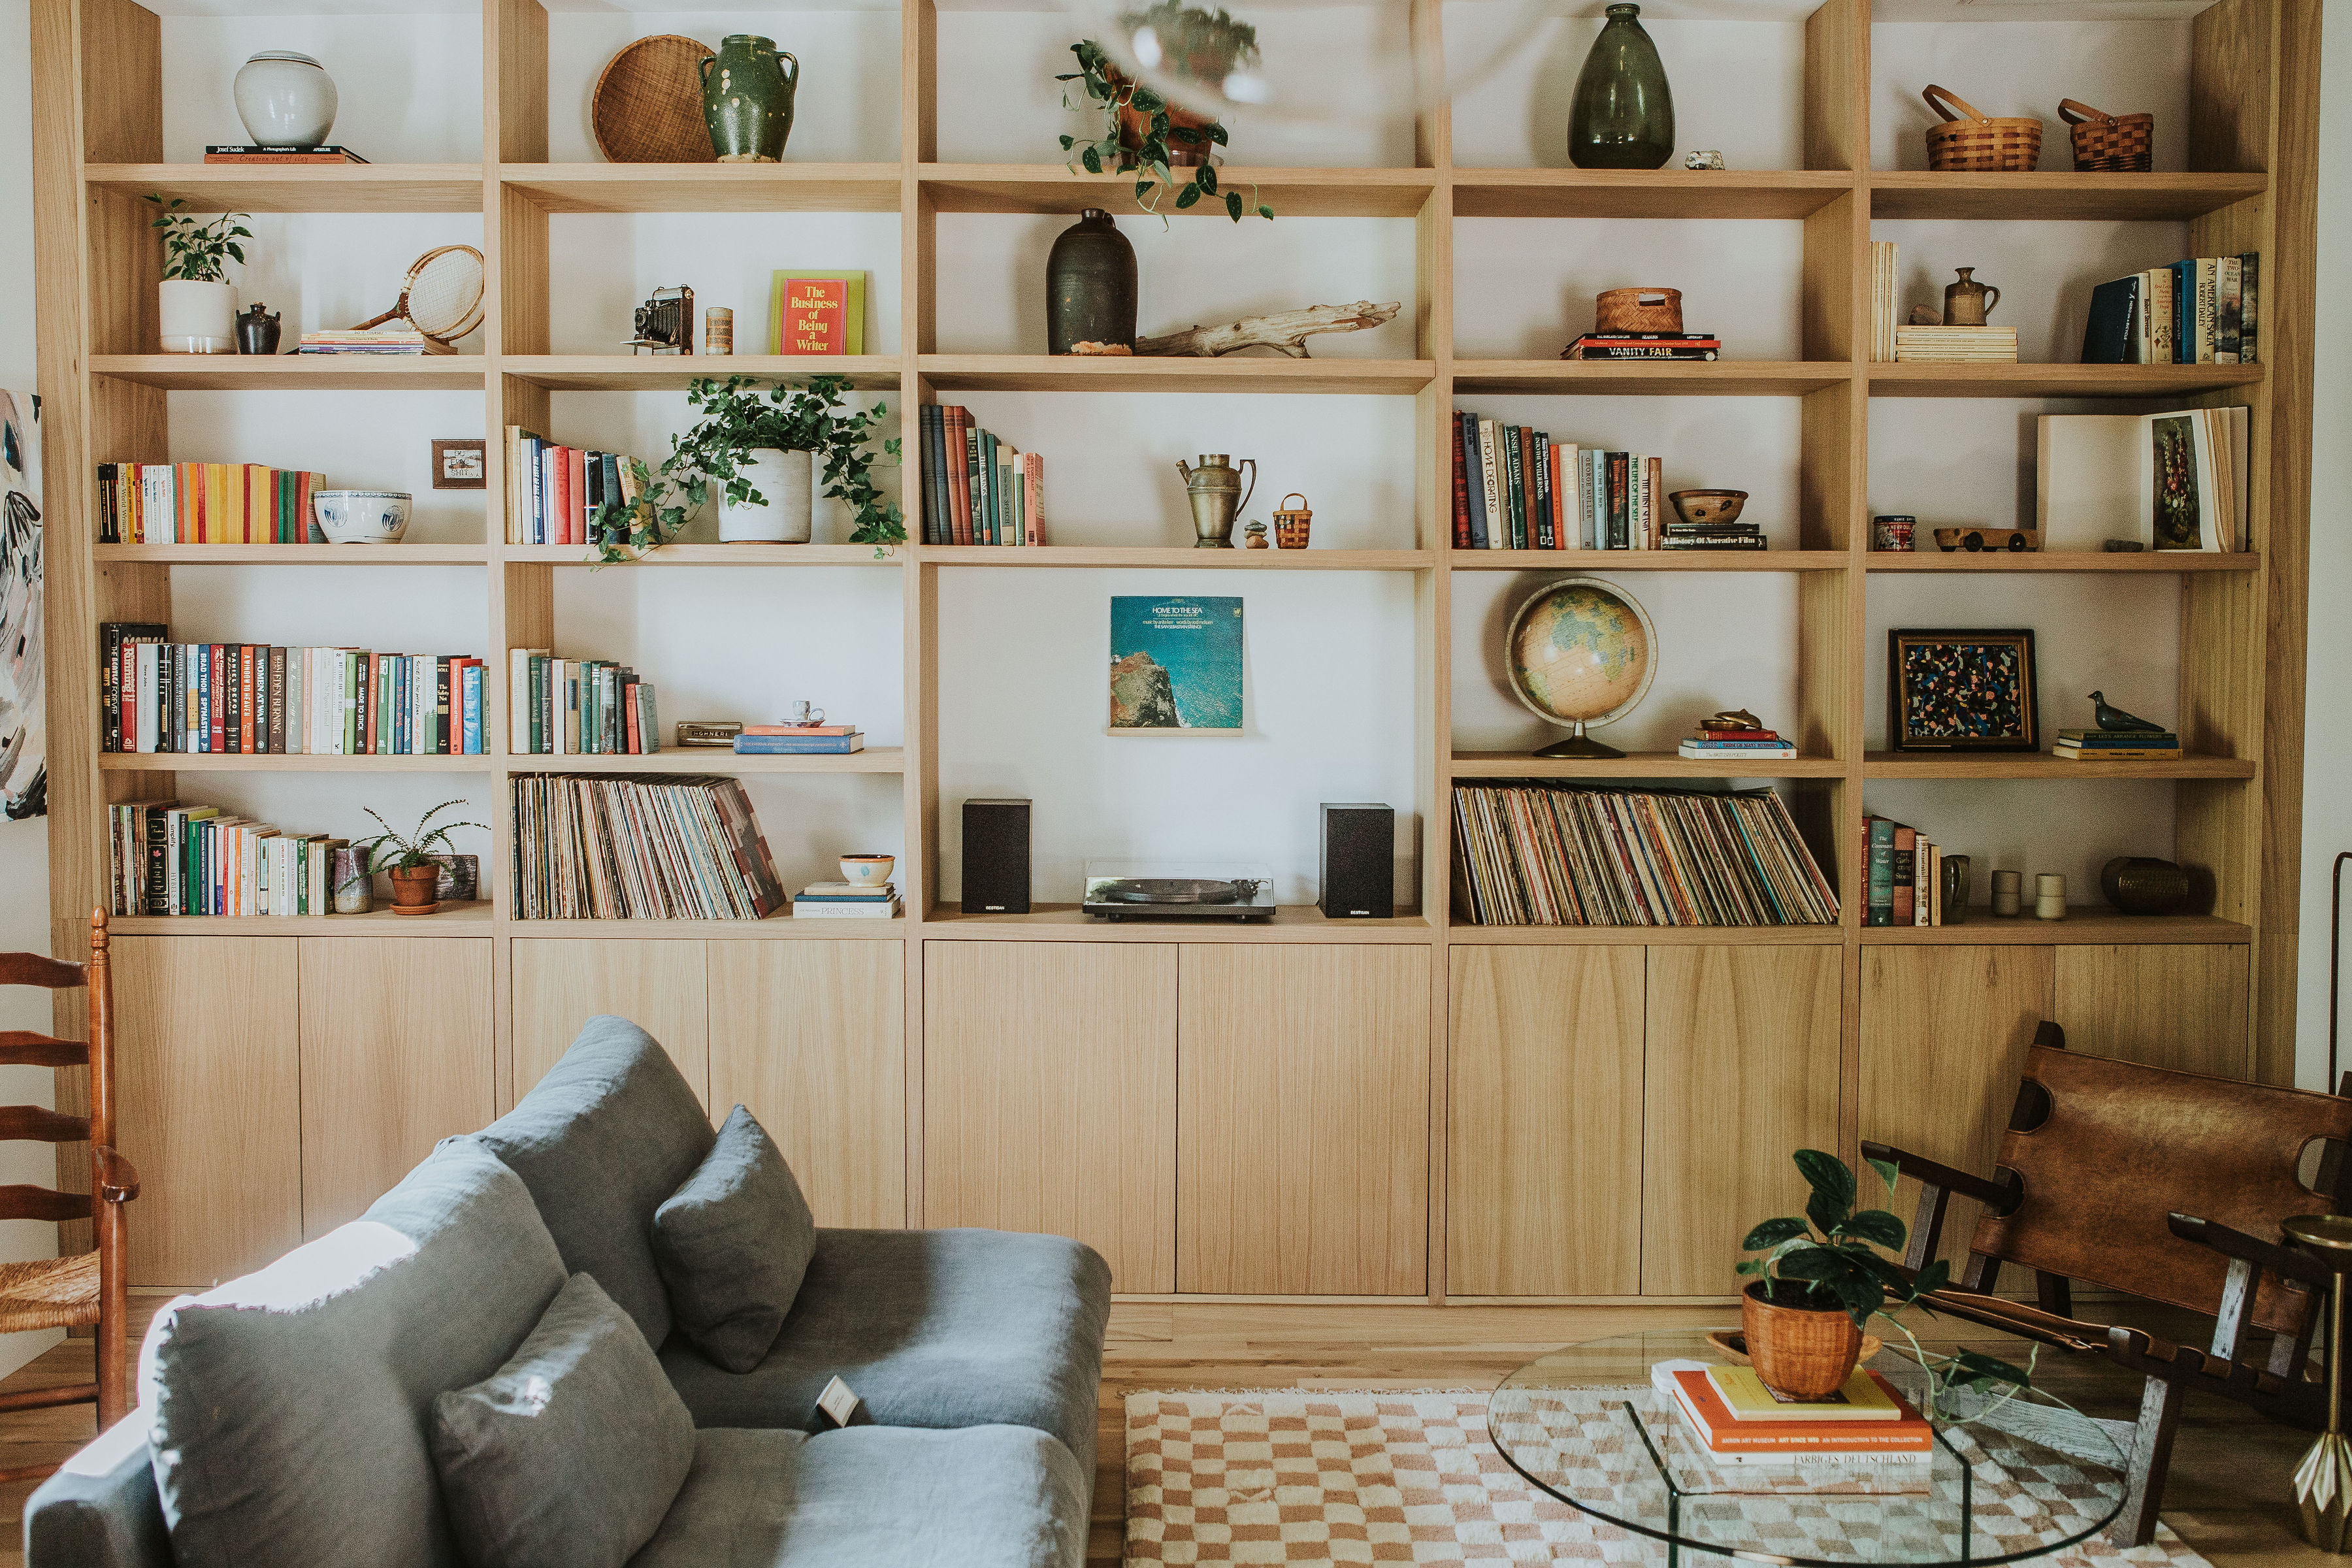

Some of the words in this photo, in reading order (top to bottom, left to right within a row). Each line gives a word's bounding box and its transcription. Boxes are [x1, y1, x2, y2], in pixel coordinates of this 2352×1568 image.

[293, 155, 308, 163] clay
[2207, 264, 2215, 276] AN
[805, 286, 825, 297] The
[791, 297, 838, 308] Business
[808, 309, 819, 319] of
[798, 319, 828, 333] Being
[796, 340, 828, 351] Writer
[1483, 442, 1494, 466] HOME
[1631, 483, 1639, 492] OF
[122, 647, 135, 693] Running
[272, 674, 281, 696] EDEN
[257, 693, 264, 704] AT
[272, 698, 281, 734] BURNING
[1793, 1455, 1840, 1464] FARBIGES
[1844, 1455, 1916, 1464] DEUTSCHLAND
